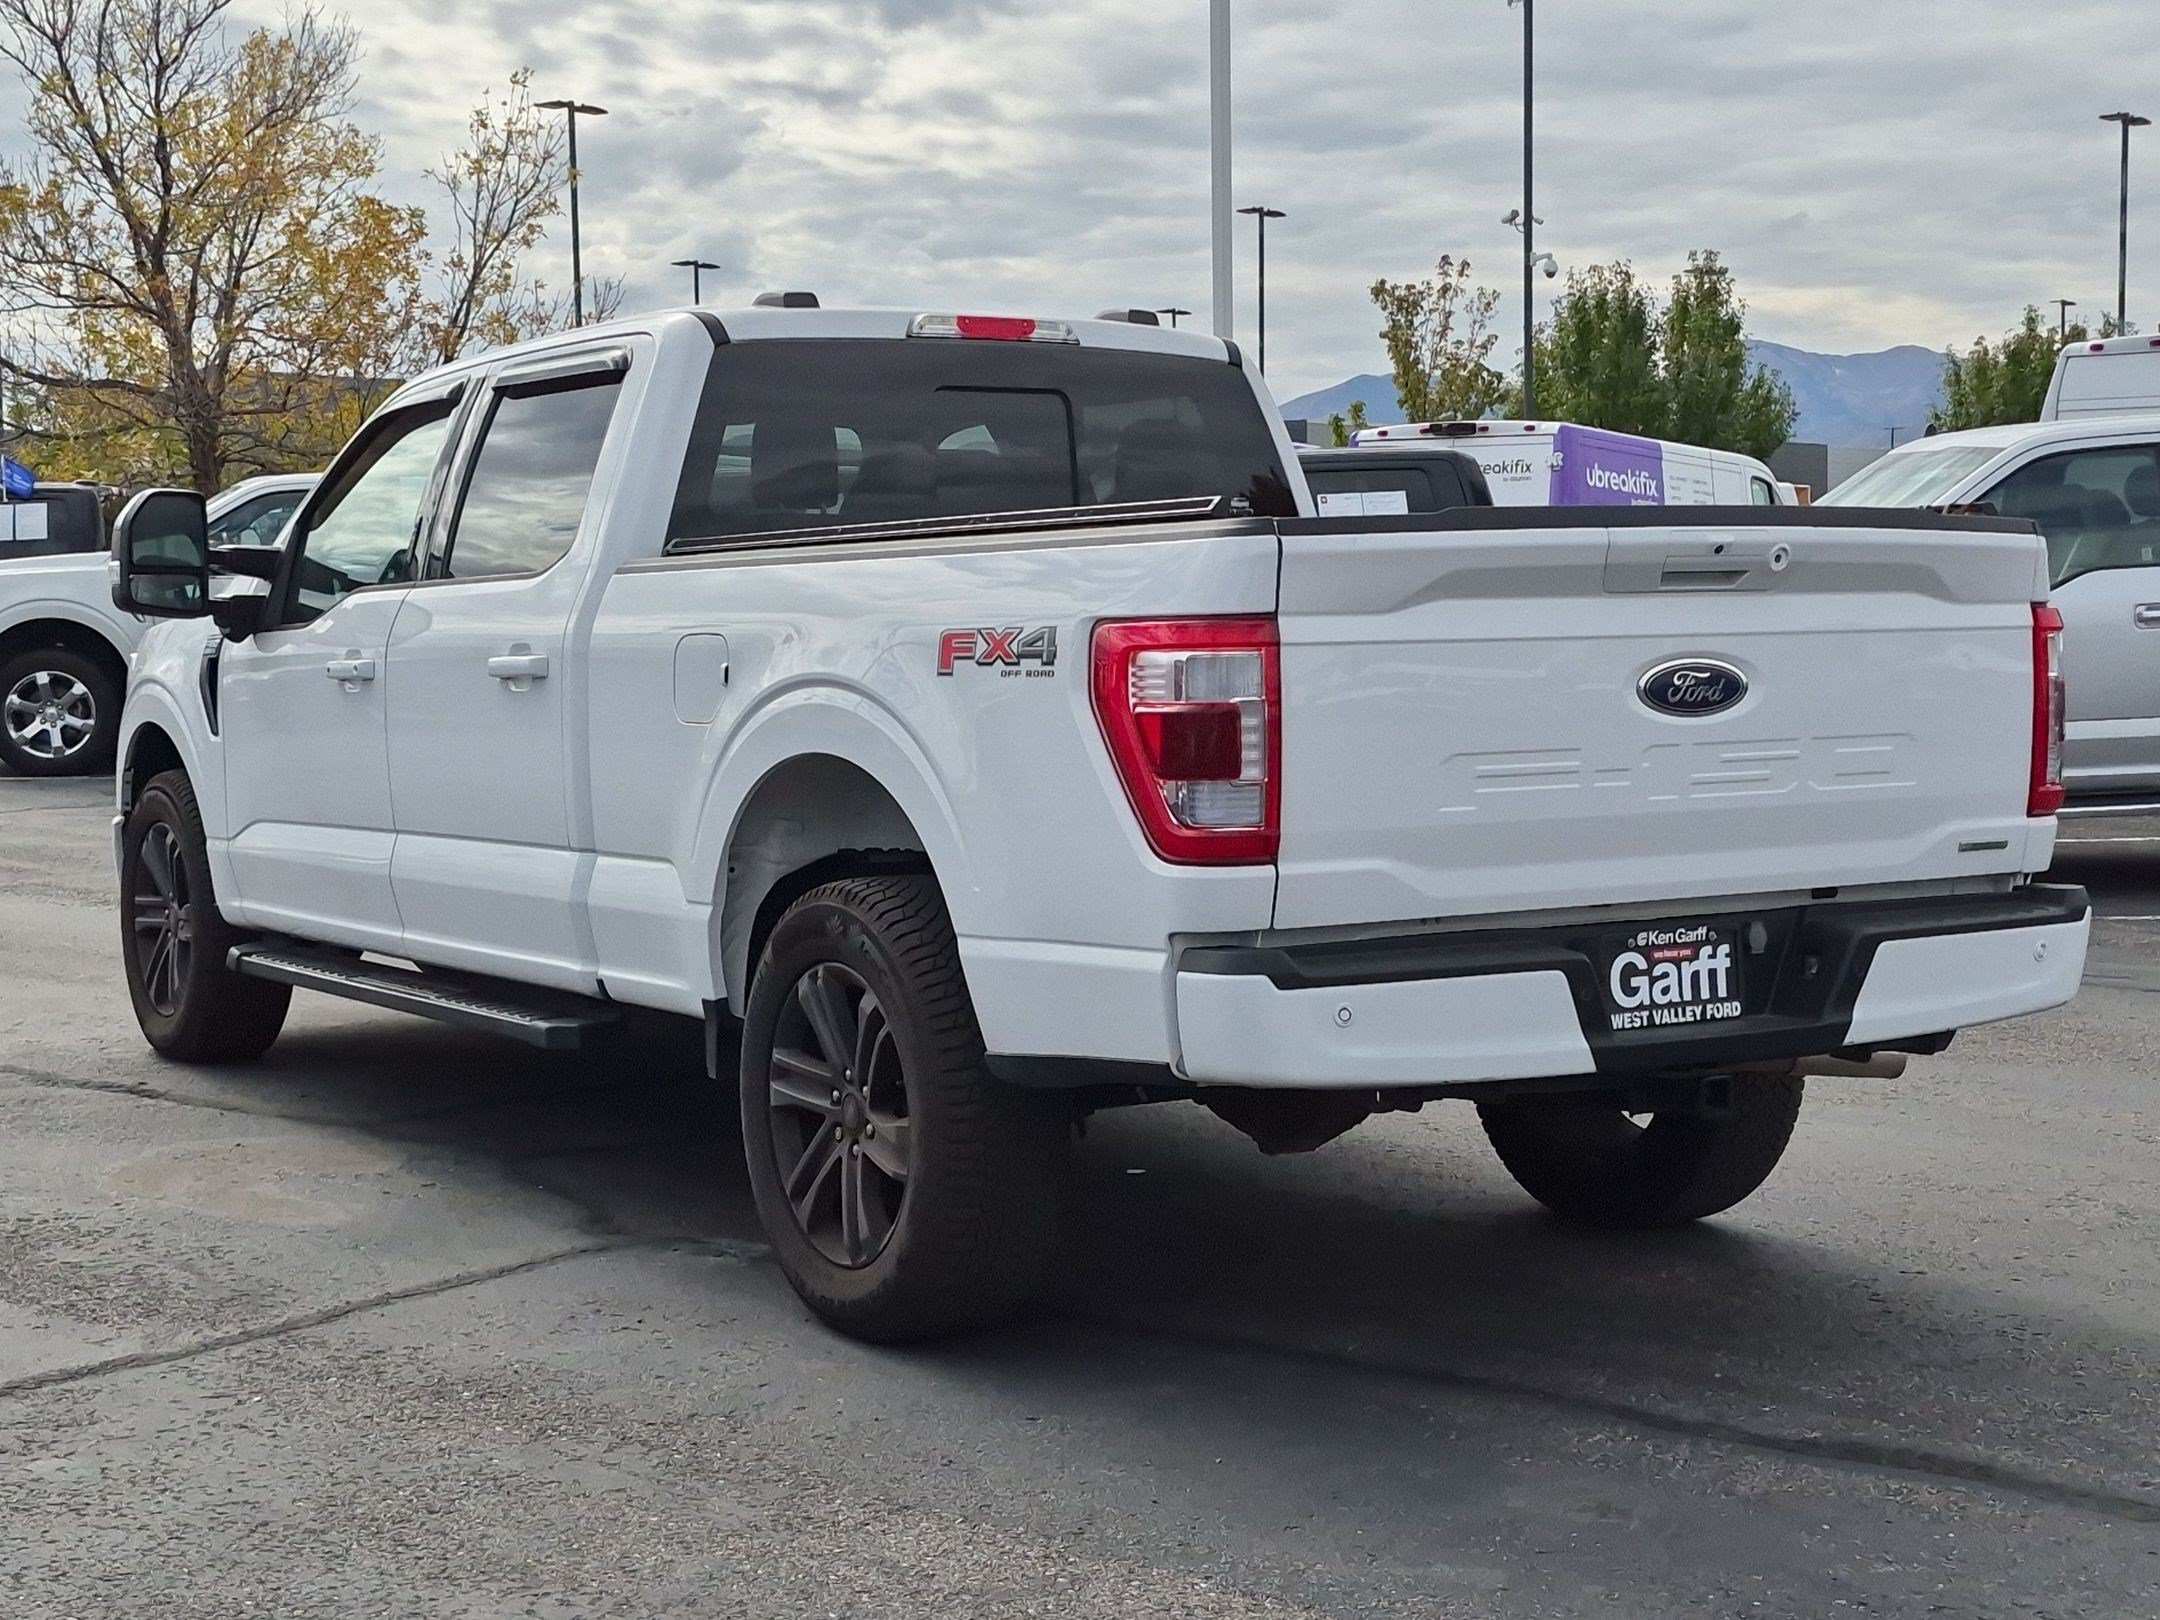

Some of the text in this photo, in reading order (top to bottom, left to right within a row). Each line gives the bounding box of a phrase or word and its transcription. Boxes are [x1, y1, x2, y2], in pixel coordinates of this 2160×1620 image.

[1586, 462, 1658, 497] ubreakifix
[937, 626, 1057, 676] FX4
[1000, 669, 1055, 678] OFF ROAD
[1667, 670, 1725, 703] Ford
[1648, 926, 1707, 945] Ken Garff
[1610, 944, 1731, 1008] Garff
[1611, 1001, 1742, 1029] WEST VALLEY FORD
